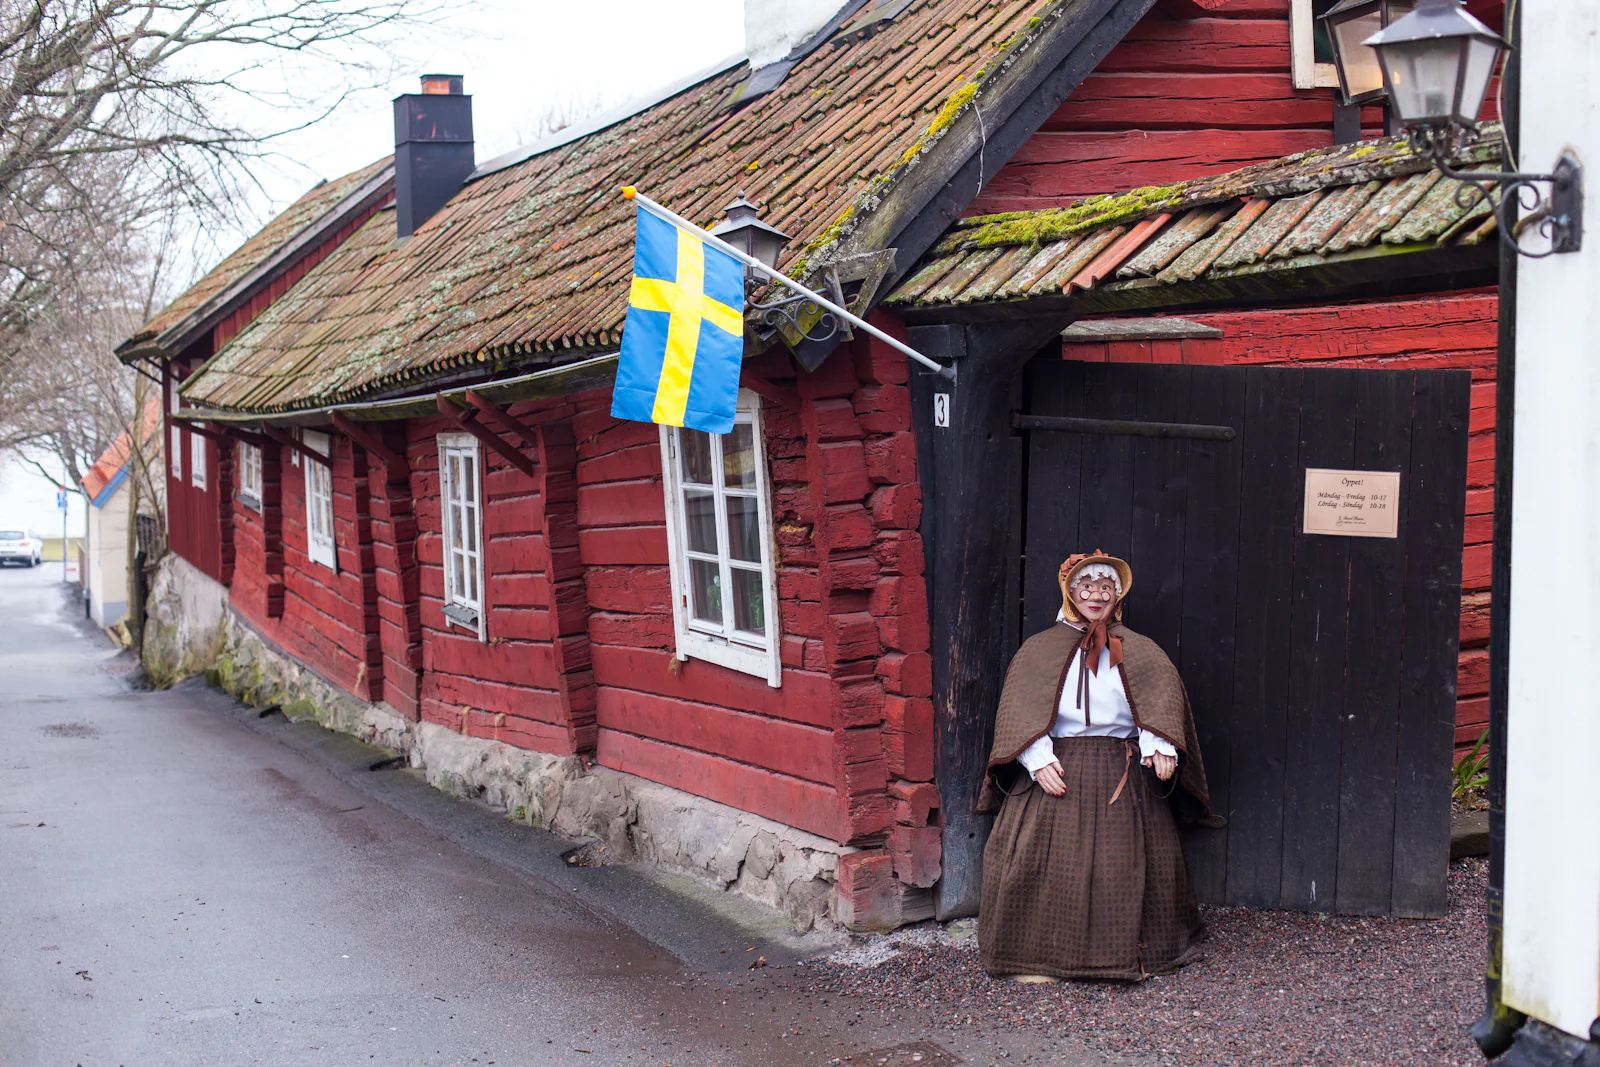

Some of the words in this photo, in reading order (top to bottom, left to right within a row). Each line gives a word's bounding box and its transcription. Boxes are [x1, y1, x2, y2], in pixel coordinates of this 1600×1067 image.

[937, 395, 945, 425] 3
[1341, 477, 1364, 487] Öppet!
[1317, 492, 1341, 500] Måndag
[1317, 501, 1338, 509] Lördag
[1342, 502, 1363, 510] Söndag
